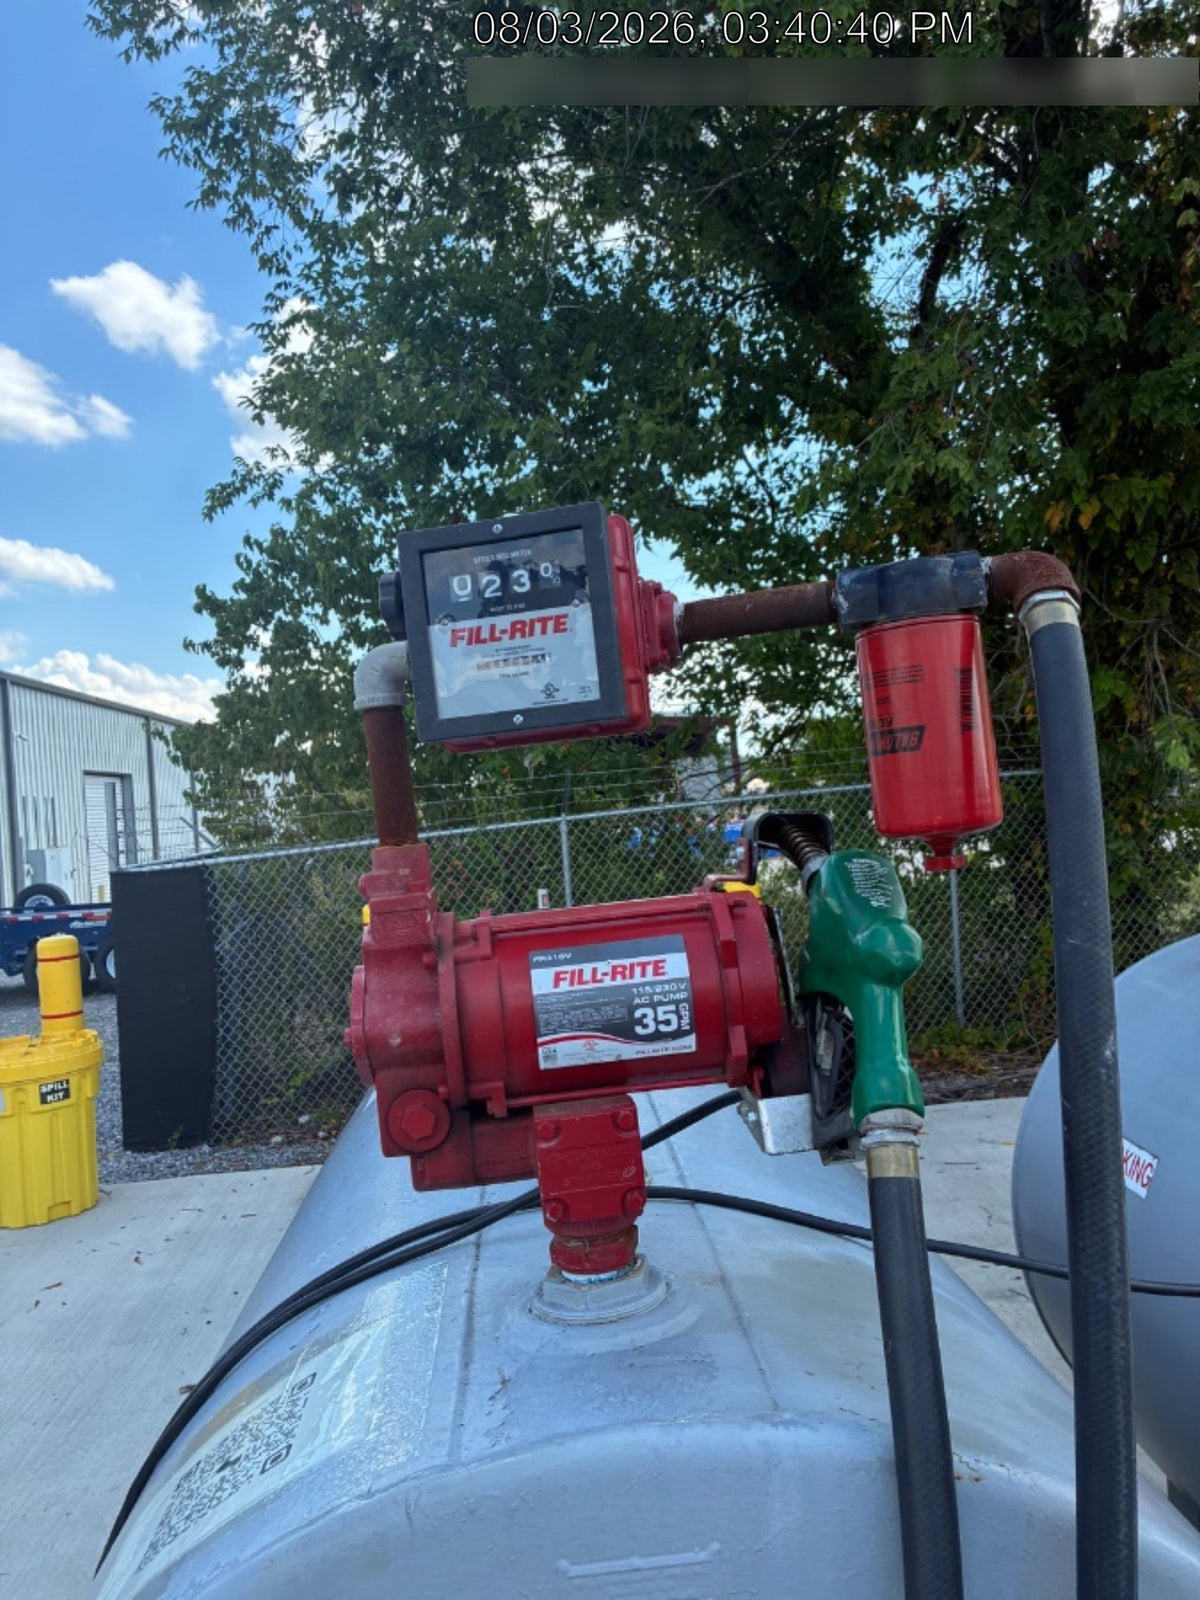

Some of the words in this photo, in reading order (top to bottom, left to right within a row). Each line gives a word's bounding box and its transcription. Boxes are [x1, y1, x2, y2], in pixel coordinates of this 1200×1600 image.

[450, 614, 569, 648] FILL-RITE
[552, 959, 667, 989] FILL-RITE
[632, 995, 651, 1006] AC
[653, 991, 688, 1003] PUMP
[633, 1003, 679, 1036] 35
[678, 1002, 691, 1031] GPM
[40, 1080, 69, 1094] SPILL
[47, 1091, 65, 1104] KIT
